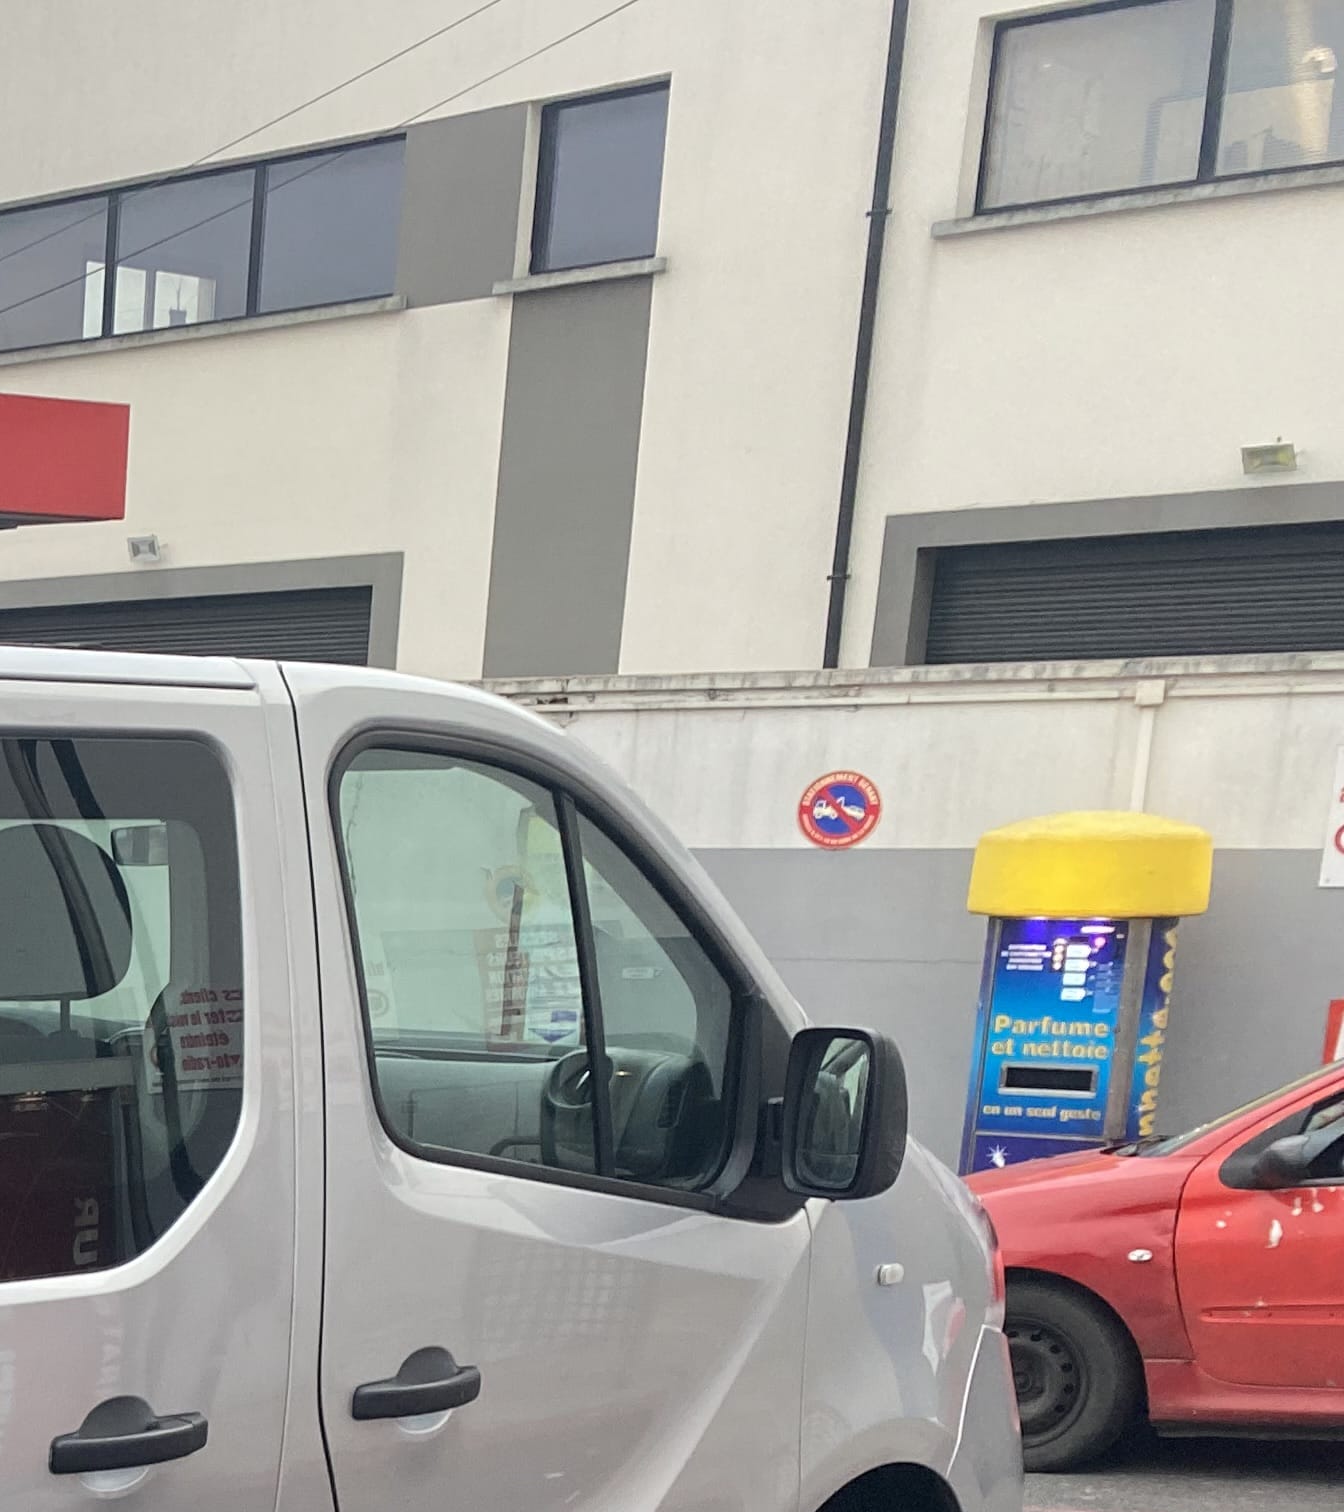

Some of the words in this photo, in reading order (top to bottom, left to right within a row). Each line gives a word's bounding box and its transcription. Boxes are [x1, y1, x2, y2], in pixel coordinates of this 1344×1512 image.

[994, 1015, 1109, 1037] Parfume
[991, 1039, 1015, 1056] et
[1023, 1040, 1108, 1059] nettoie
